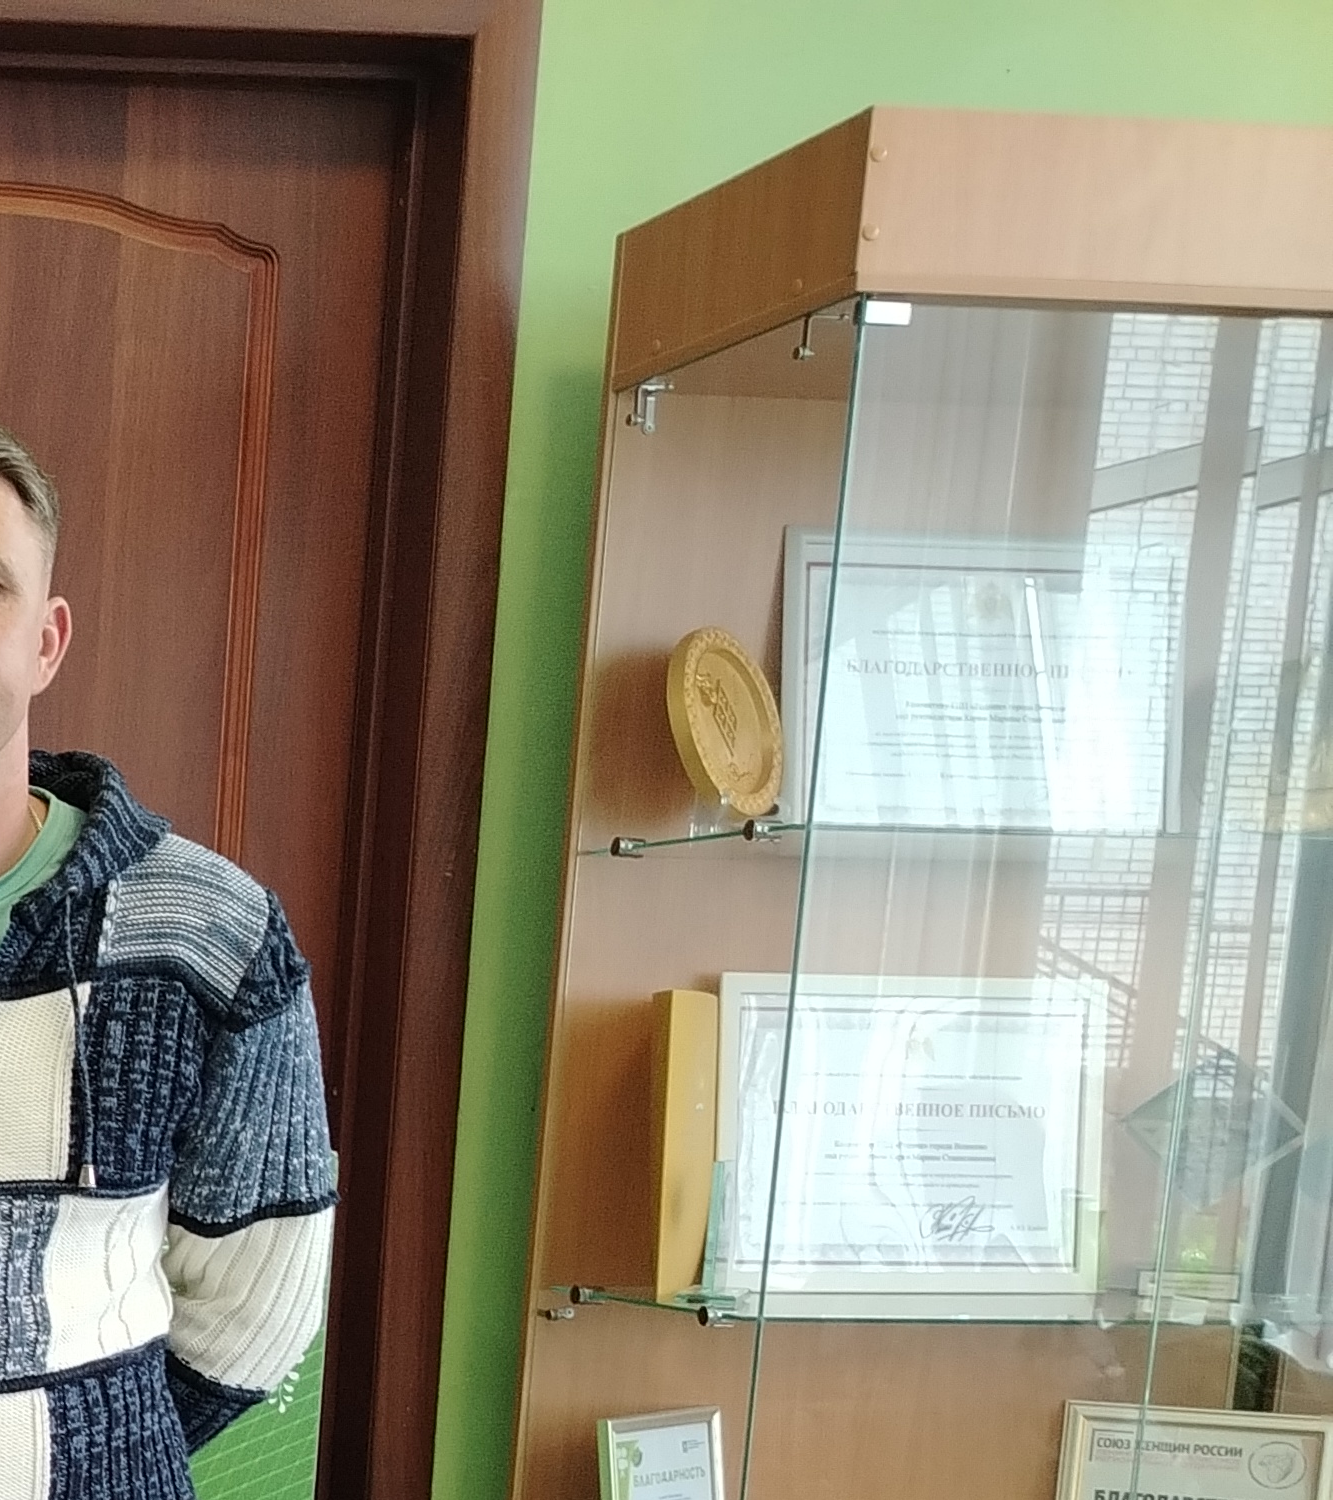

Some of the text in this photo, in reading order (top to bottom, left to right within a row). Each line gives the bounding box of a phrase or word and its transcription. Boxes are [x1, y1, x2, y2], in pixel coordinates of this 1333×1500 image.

[846, 658, 1038, 680] БЛАГОДАРСТВЕННО
[969, 1103, 1046, 1119] ПИСЬМО
[1097, 1436, 1131, 1450] СОЮЗ
[1193, 1444, 1243, 1458] РОССИИ
